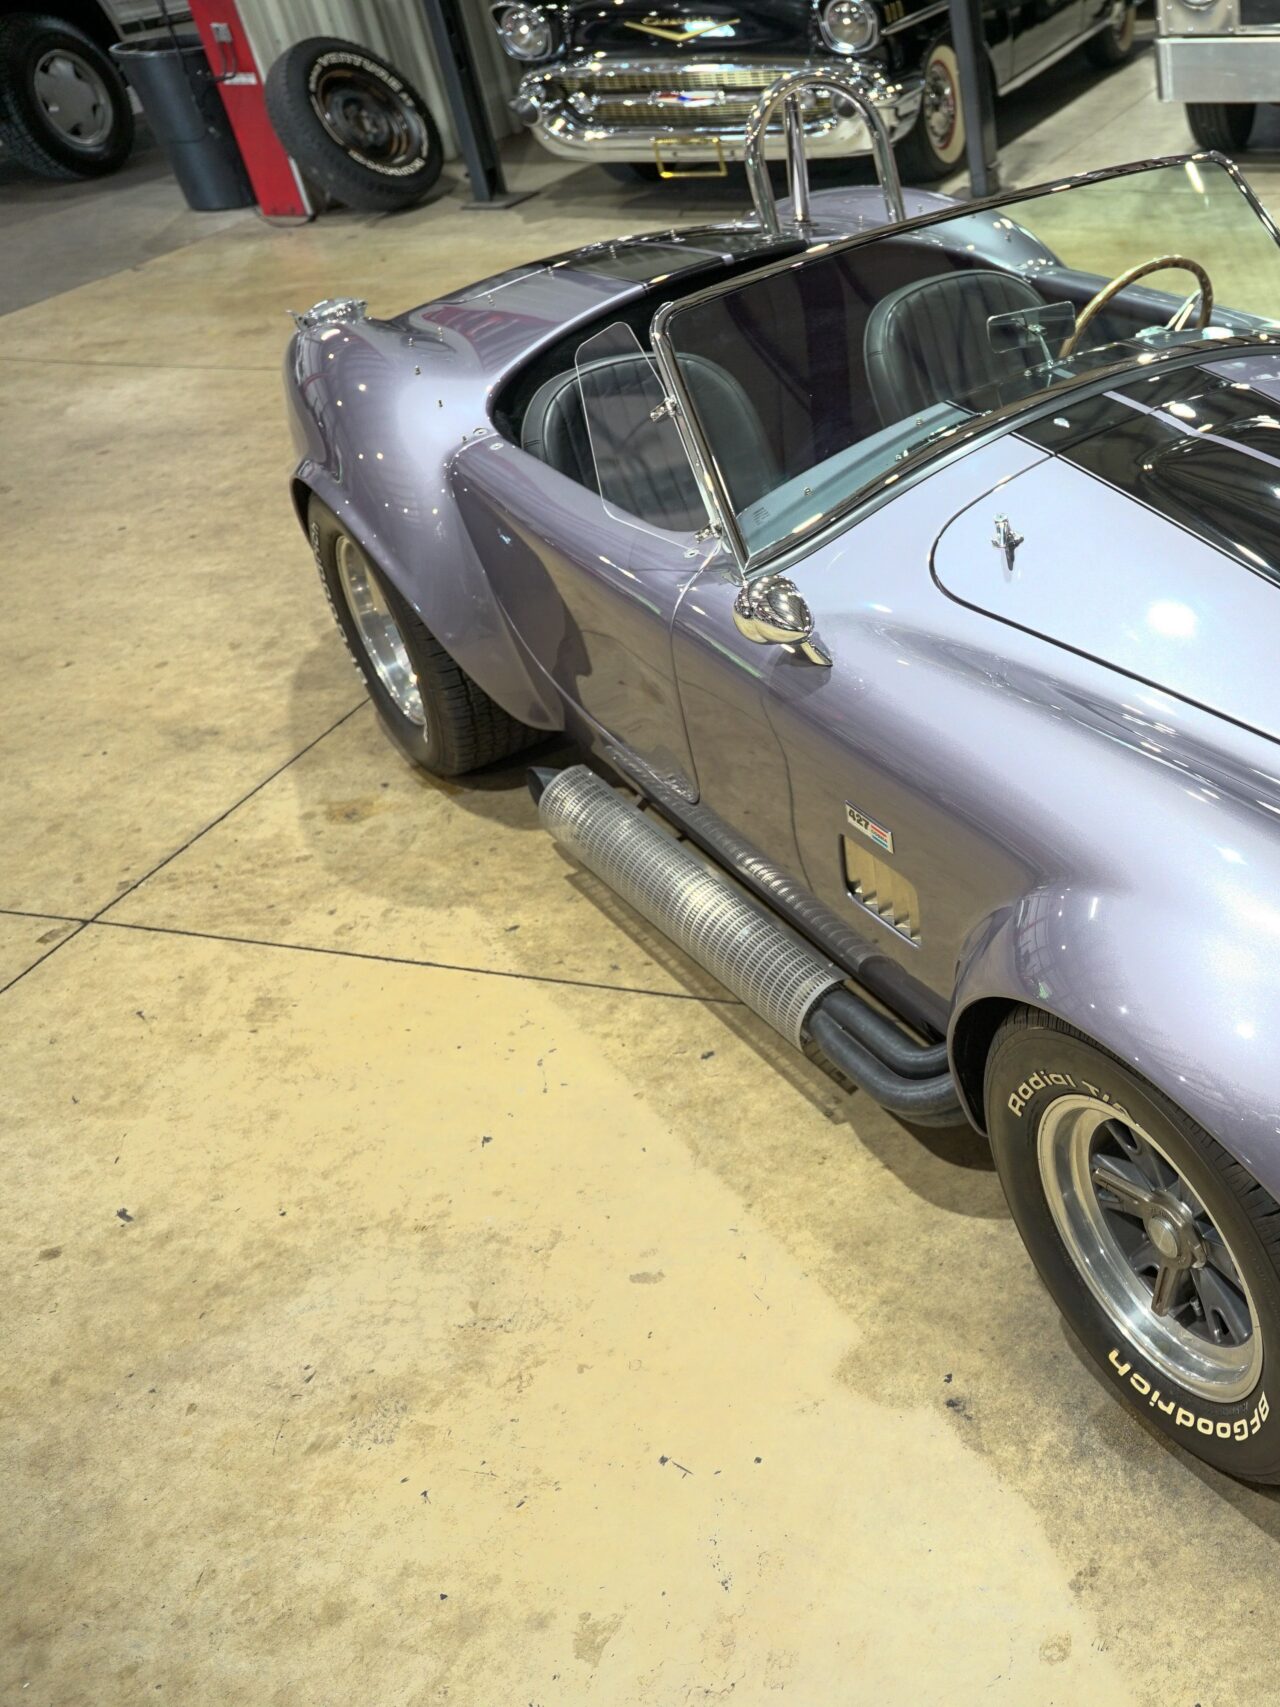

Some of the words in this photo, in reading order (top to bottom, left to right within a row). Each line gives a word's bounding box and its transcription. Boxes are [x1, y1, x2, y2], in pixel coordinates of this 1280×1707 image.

[848, 809, 870, 831] 427
[1007, 1070, 1077, 1118] Radial
[1108, 1348, 1270, 1442] BFGoodrich
